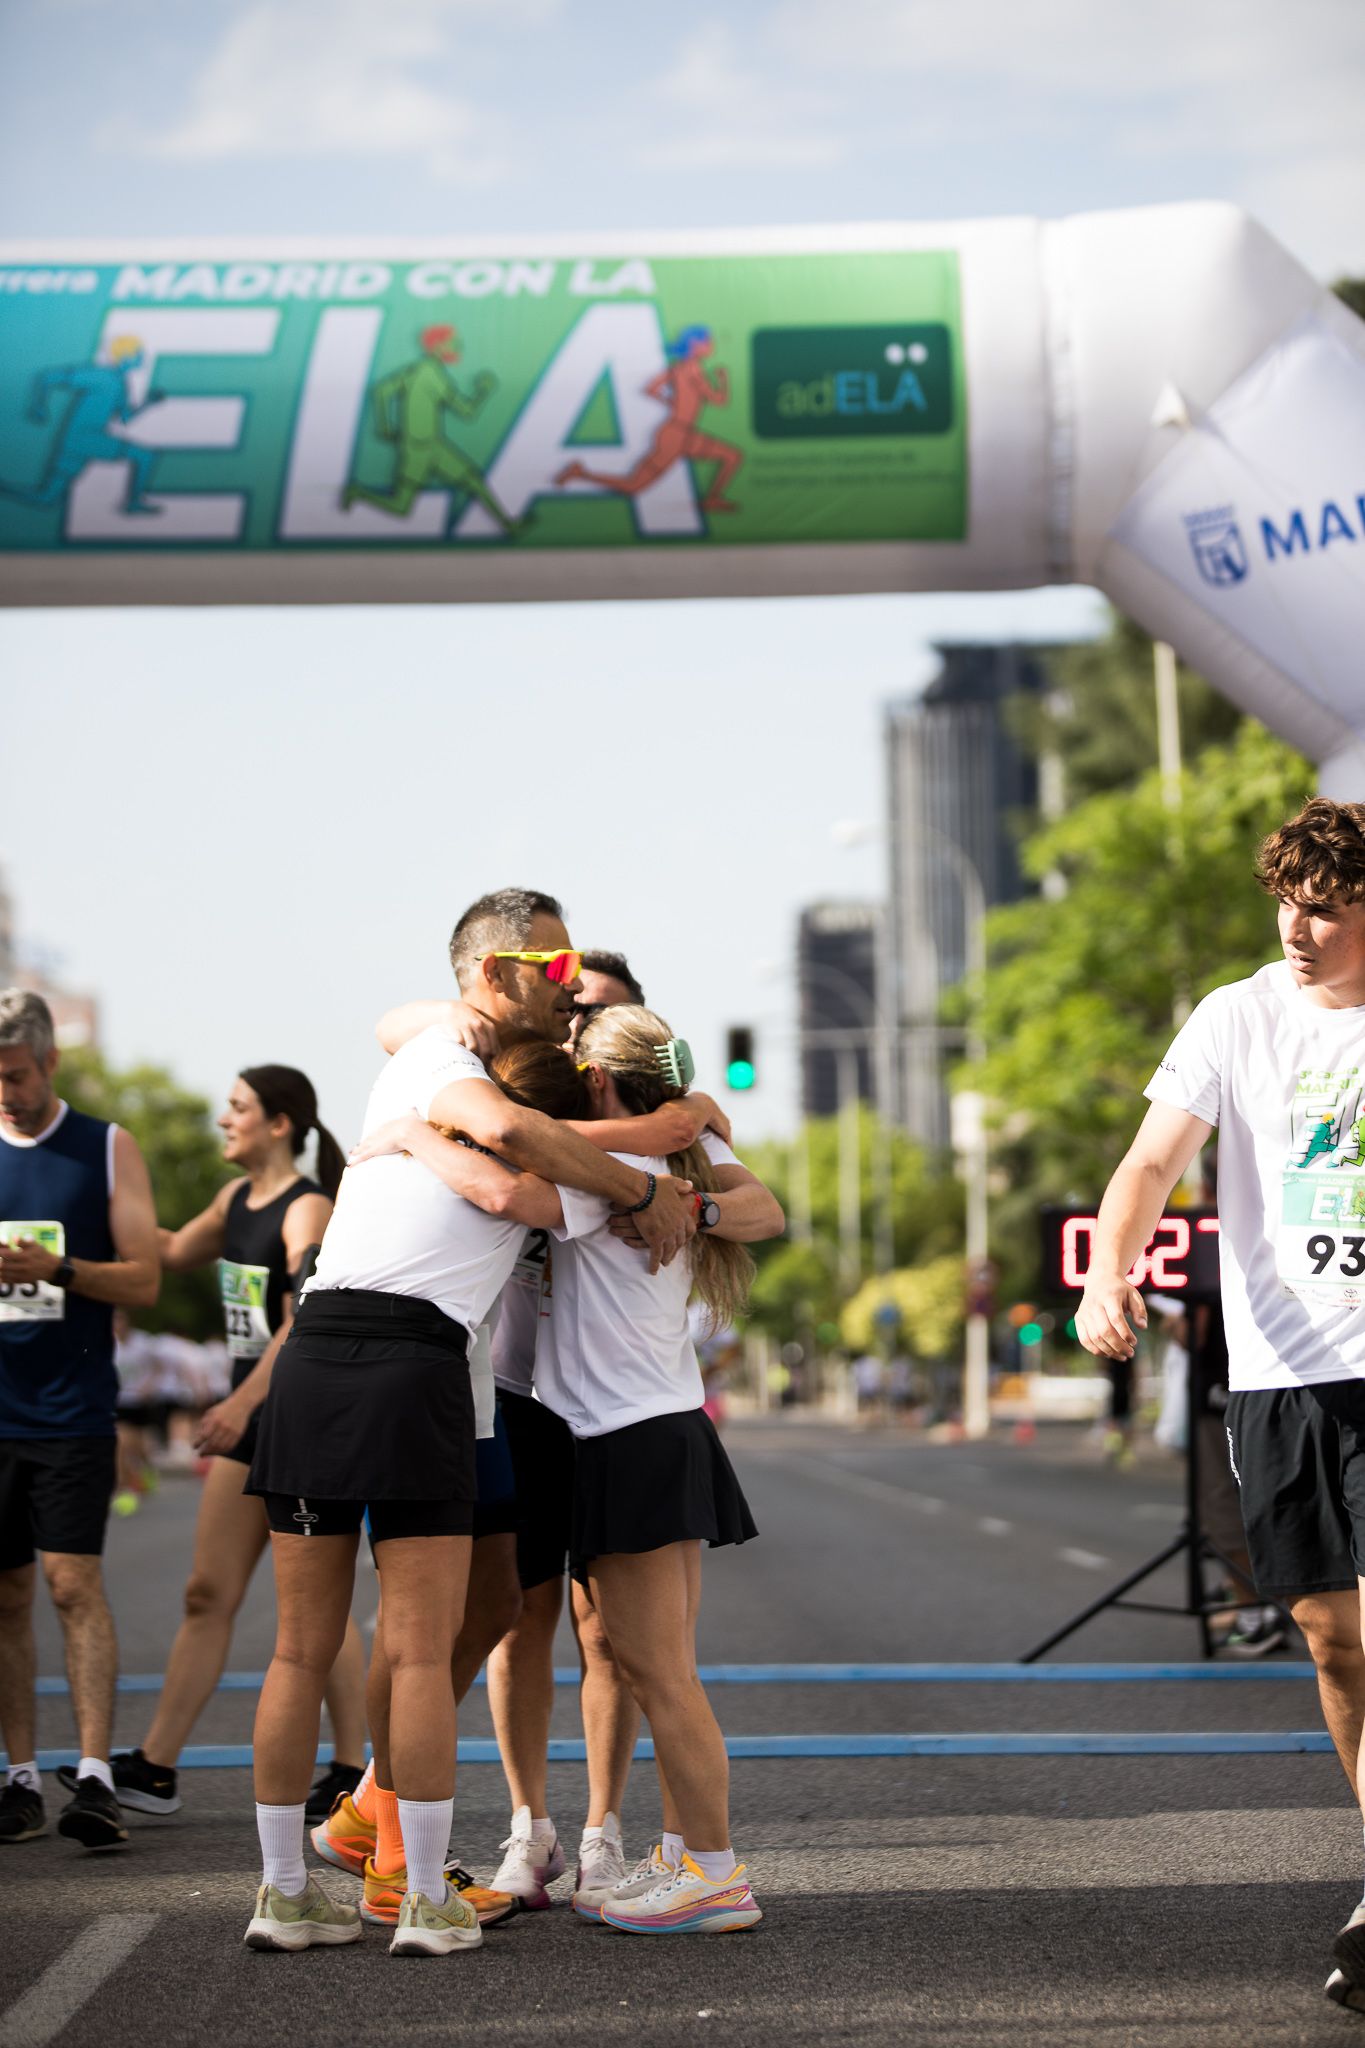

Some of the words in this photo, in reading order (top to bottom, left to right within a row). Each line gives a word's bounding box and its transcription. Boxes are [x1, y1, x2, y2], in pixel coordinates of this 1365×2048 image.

[110, 263, 393, 299] MADRID
[405, 261, 556, 299] CON
[568, 259, 657, 295] LA
[65, 302, 705, 538] ELA
[1307, 1234, 1365, 1277] 93
